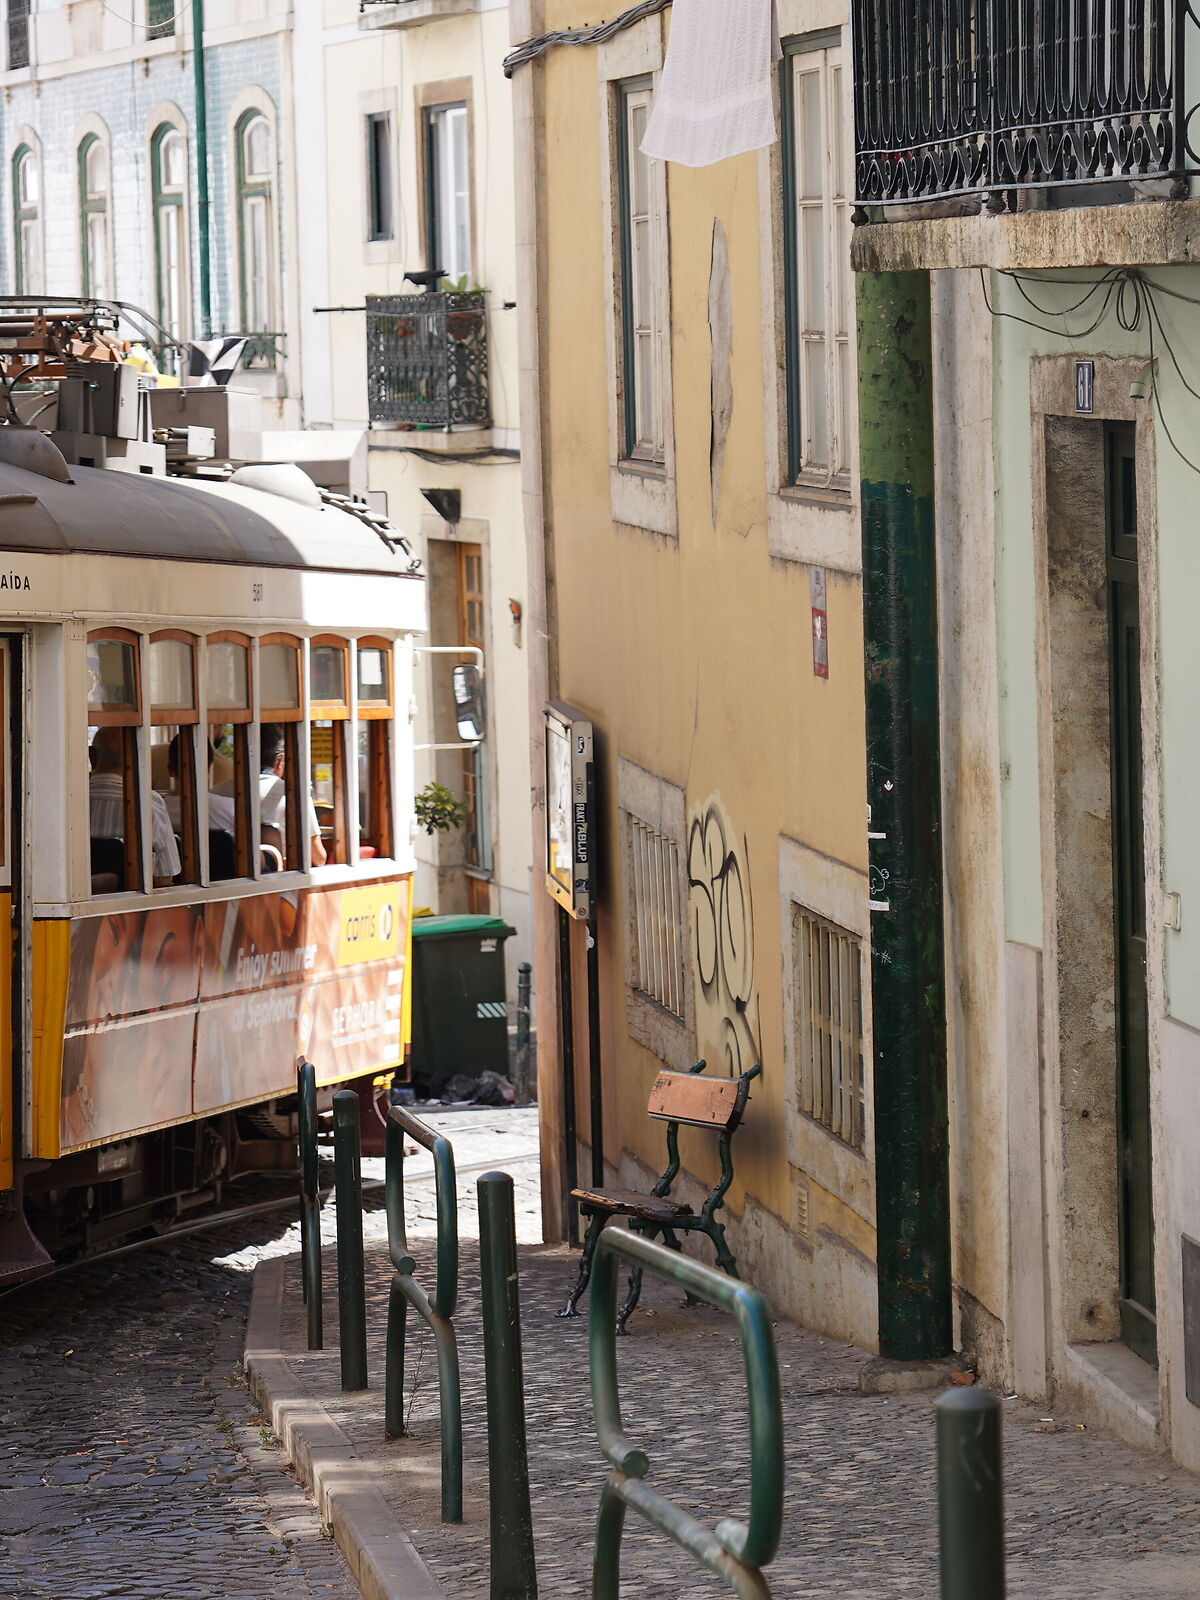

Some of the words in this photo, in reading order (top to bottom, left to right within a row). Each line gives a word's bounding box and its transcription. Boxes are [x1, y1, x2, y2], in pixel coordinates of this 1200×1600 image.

[576, 804, 585, 823] FRAKT
[236, 943, 269, 990] Enjoy
[270, 943, 318, 976] summer
[232, 1003, 246, 1032] at
